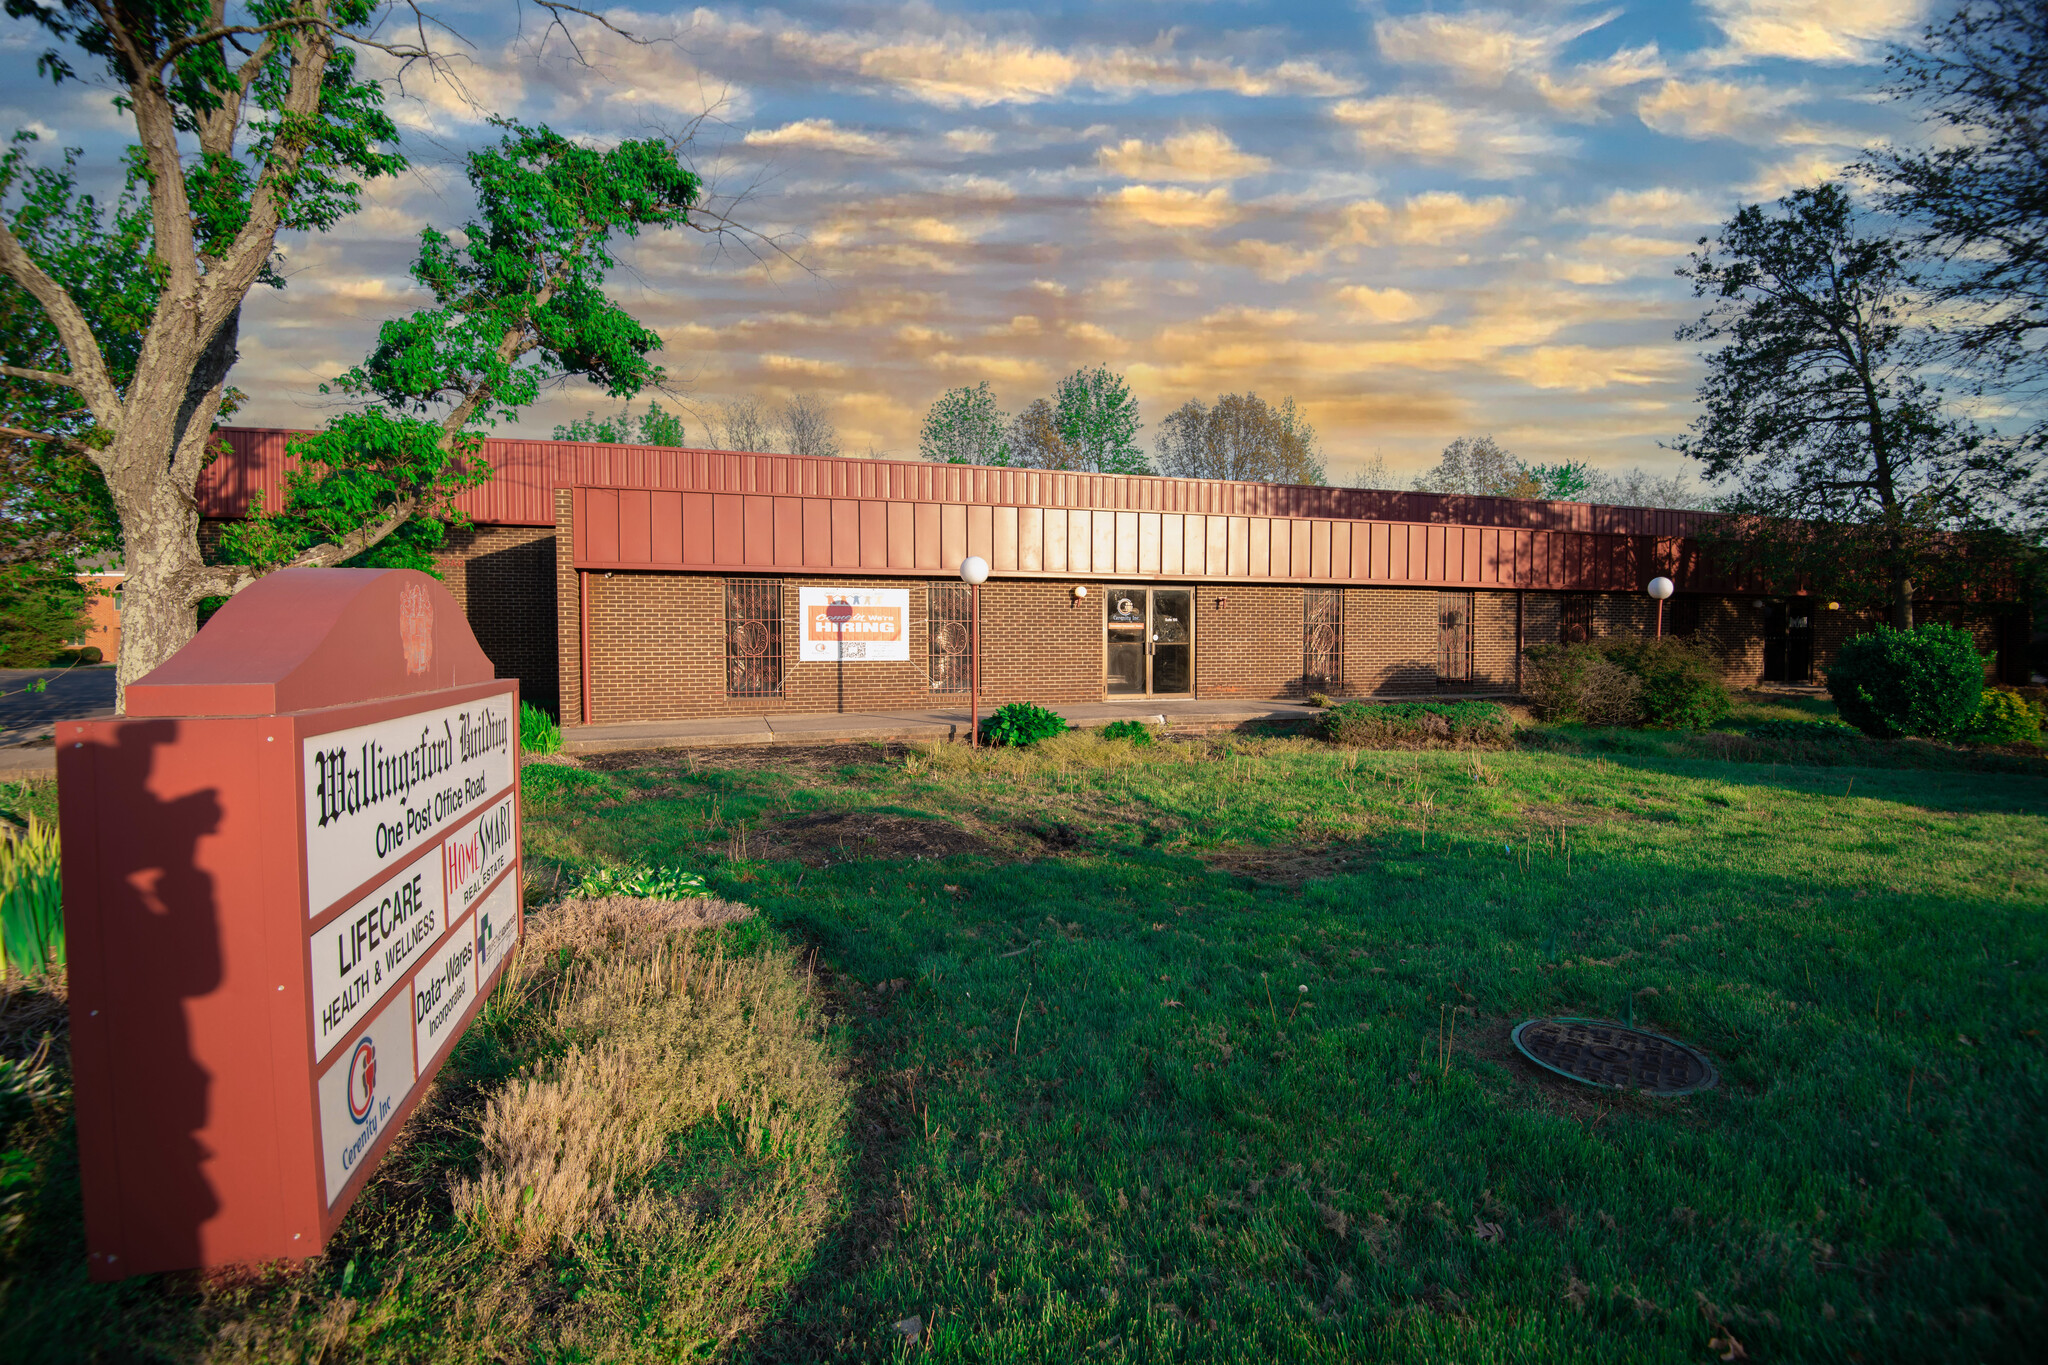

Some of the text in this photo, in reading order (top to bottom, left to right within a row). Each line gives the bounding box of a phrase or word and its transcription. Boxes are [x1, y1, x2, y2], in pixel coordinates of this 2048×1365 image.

[815, 622, 895, 633] HIRING
[816, 613, 851, 622] Come
[315, 707, 508, 829] Wallingsford Building
[375, 822, 404, 859] One
[407, 799, 432, 841] Post
[435, 787, 463, 823] Office
[464, 855, 505, 905] REAL ESTATE
[338, 873, 423, 978] LIFECARE
[322, 969, 370, 1037] HEALTH
[374, 960, 382, 985] &
[385, 910, 435, 973] WELLNESS
[416, 941, 473, 1025] Data-Wares
[429, 976, 466, 1038] Incorporated
[342, 1095, 391, 1170] Cerenity Inc
